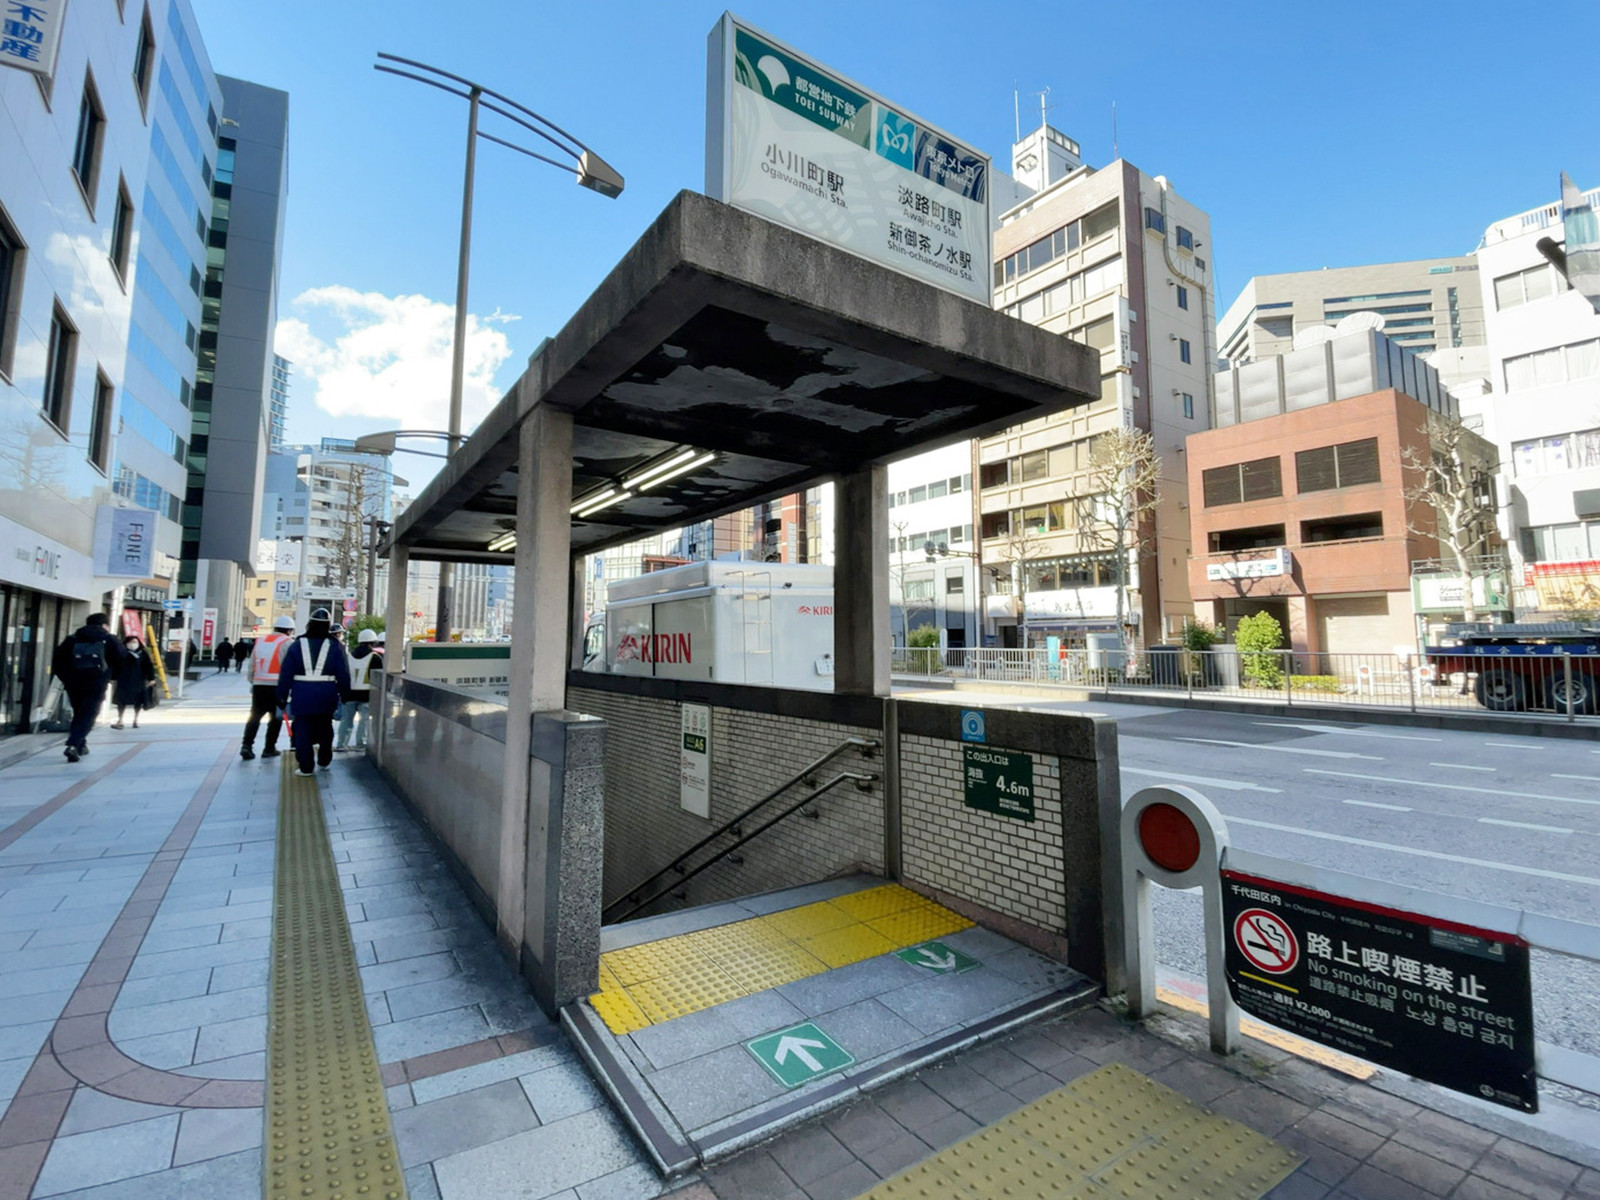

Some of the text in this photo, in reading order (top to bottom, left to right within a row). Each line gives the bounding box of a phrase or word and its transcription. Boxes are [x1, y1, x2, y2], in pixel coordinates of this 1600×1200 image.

[0, 0, 48, 63] 不動産
[794, 75, 856, 120] 都営地下鉄
[794, 92, 856, 133] TOEI SUBWAY
[765, 142, 845, 197] 小川町駅
[926, 144, 975, 180] 東京メトロ
[929, 160, 973, 188] Tokyo Metro
[760, 161, 848, 209] Ogawamachi Sta.
[897, 184, 963, 231] 淡路町駅
[902, 208, 958, 239] Awajicho Sta.
[887, 239, 975, 283] Shin-ochanomizu Sta.
[888, 220, 972, 272] 新御茶ノ水駅
[813, 605, 833, 616] KIRI
[641, 632, 692, 664] KIRIN
[966, 751, 1010, 766] この出入口は
[995, 774, 1030, 798] 4.6m
[1231, 884, 1282, 906] 千代田区内
[1321, 910, 1337, 921] City
[1306, 931, 1489, 1004] 路上喫煙禁止
[1294, 1000, 1332, 1020] ¥2,000
[1307, 958, 1516, 1032] No smoking on the street
[1308, 975, 1396, 1014] 道路禁止吸烟
[1405, 1005, 1515, 1051] 노상 흡연 금지
